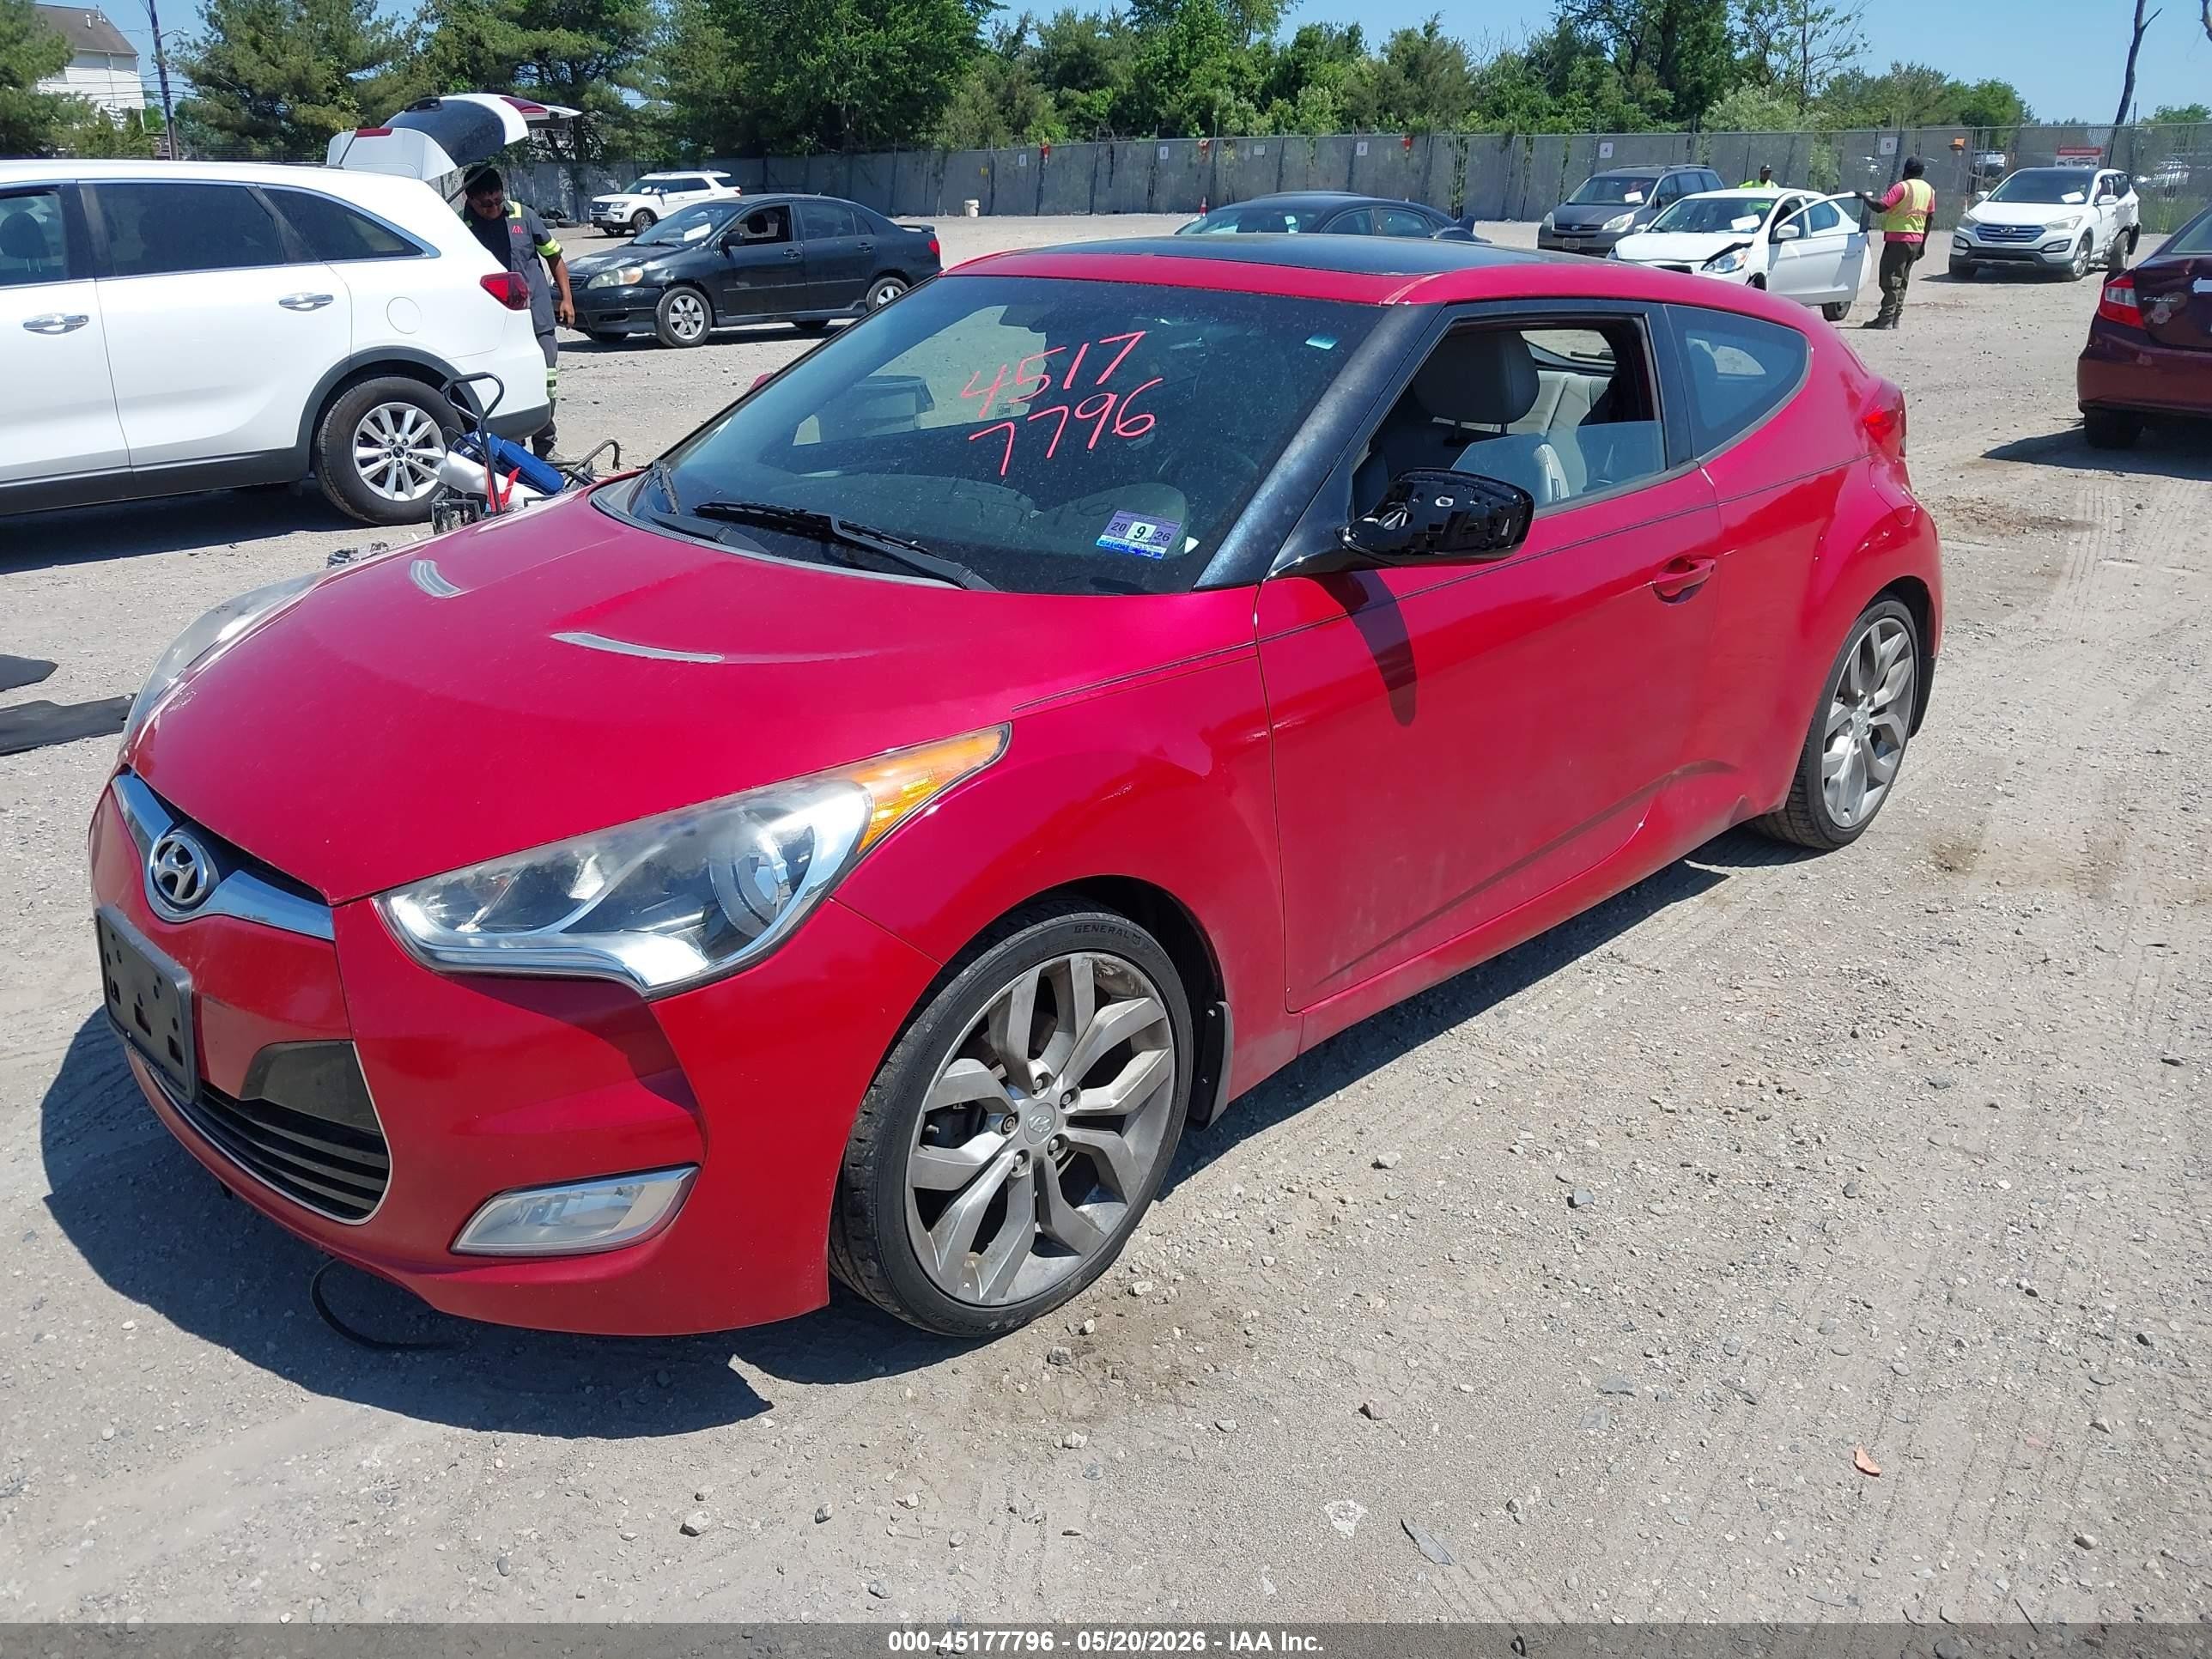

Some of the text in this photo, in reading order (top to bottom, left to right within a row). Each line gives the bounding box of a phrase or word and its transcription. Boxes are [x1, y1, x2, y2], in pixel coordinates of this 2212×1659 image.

[960, 330, 1147, 419] 4517
[968, 377, 1164, 477] 7796
[1110, 521, 1171, 542] 20 9 26
[1073, 925, 1131, 939] GENERAL
